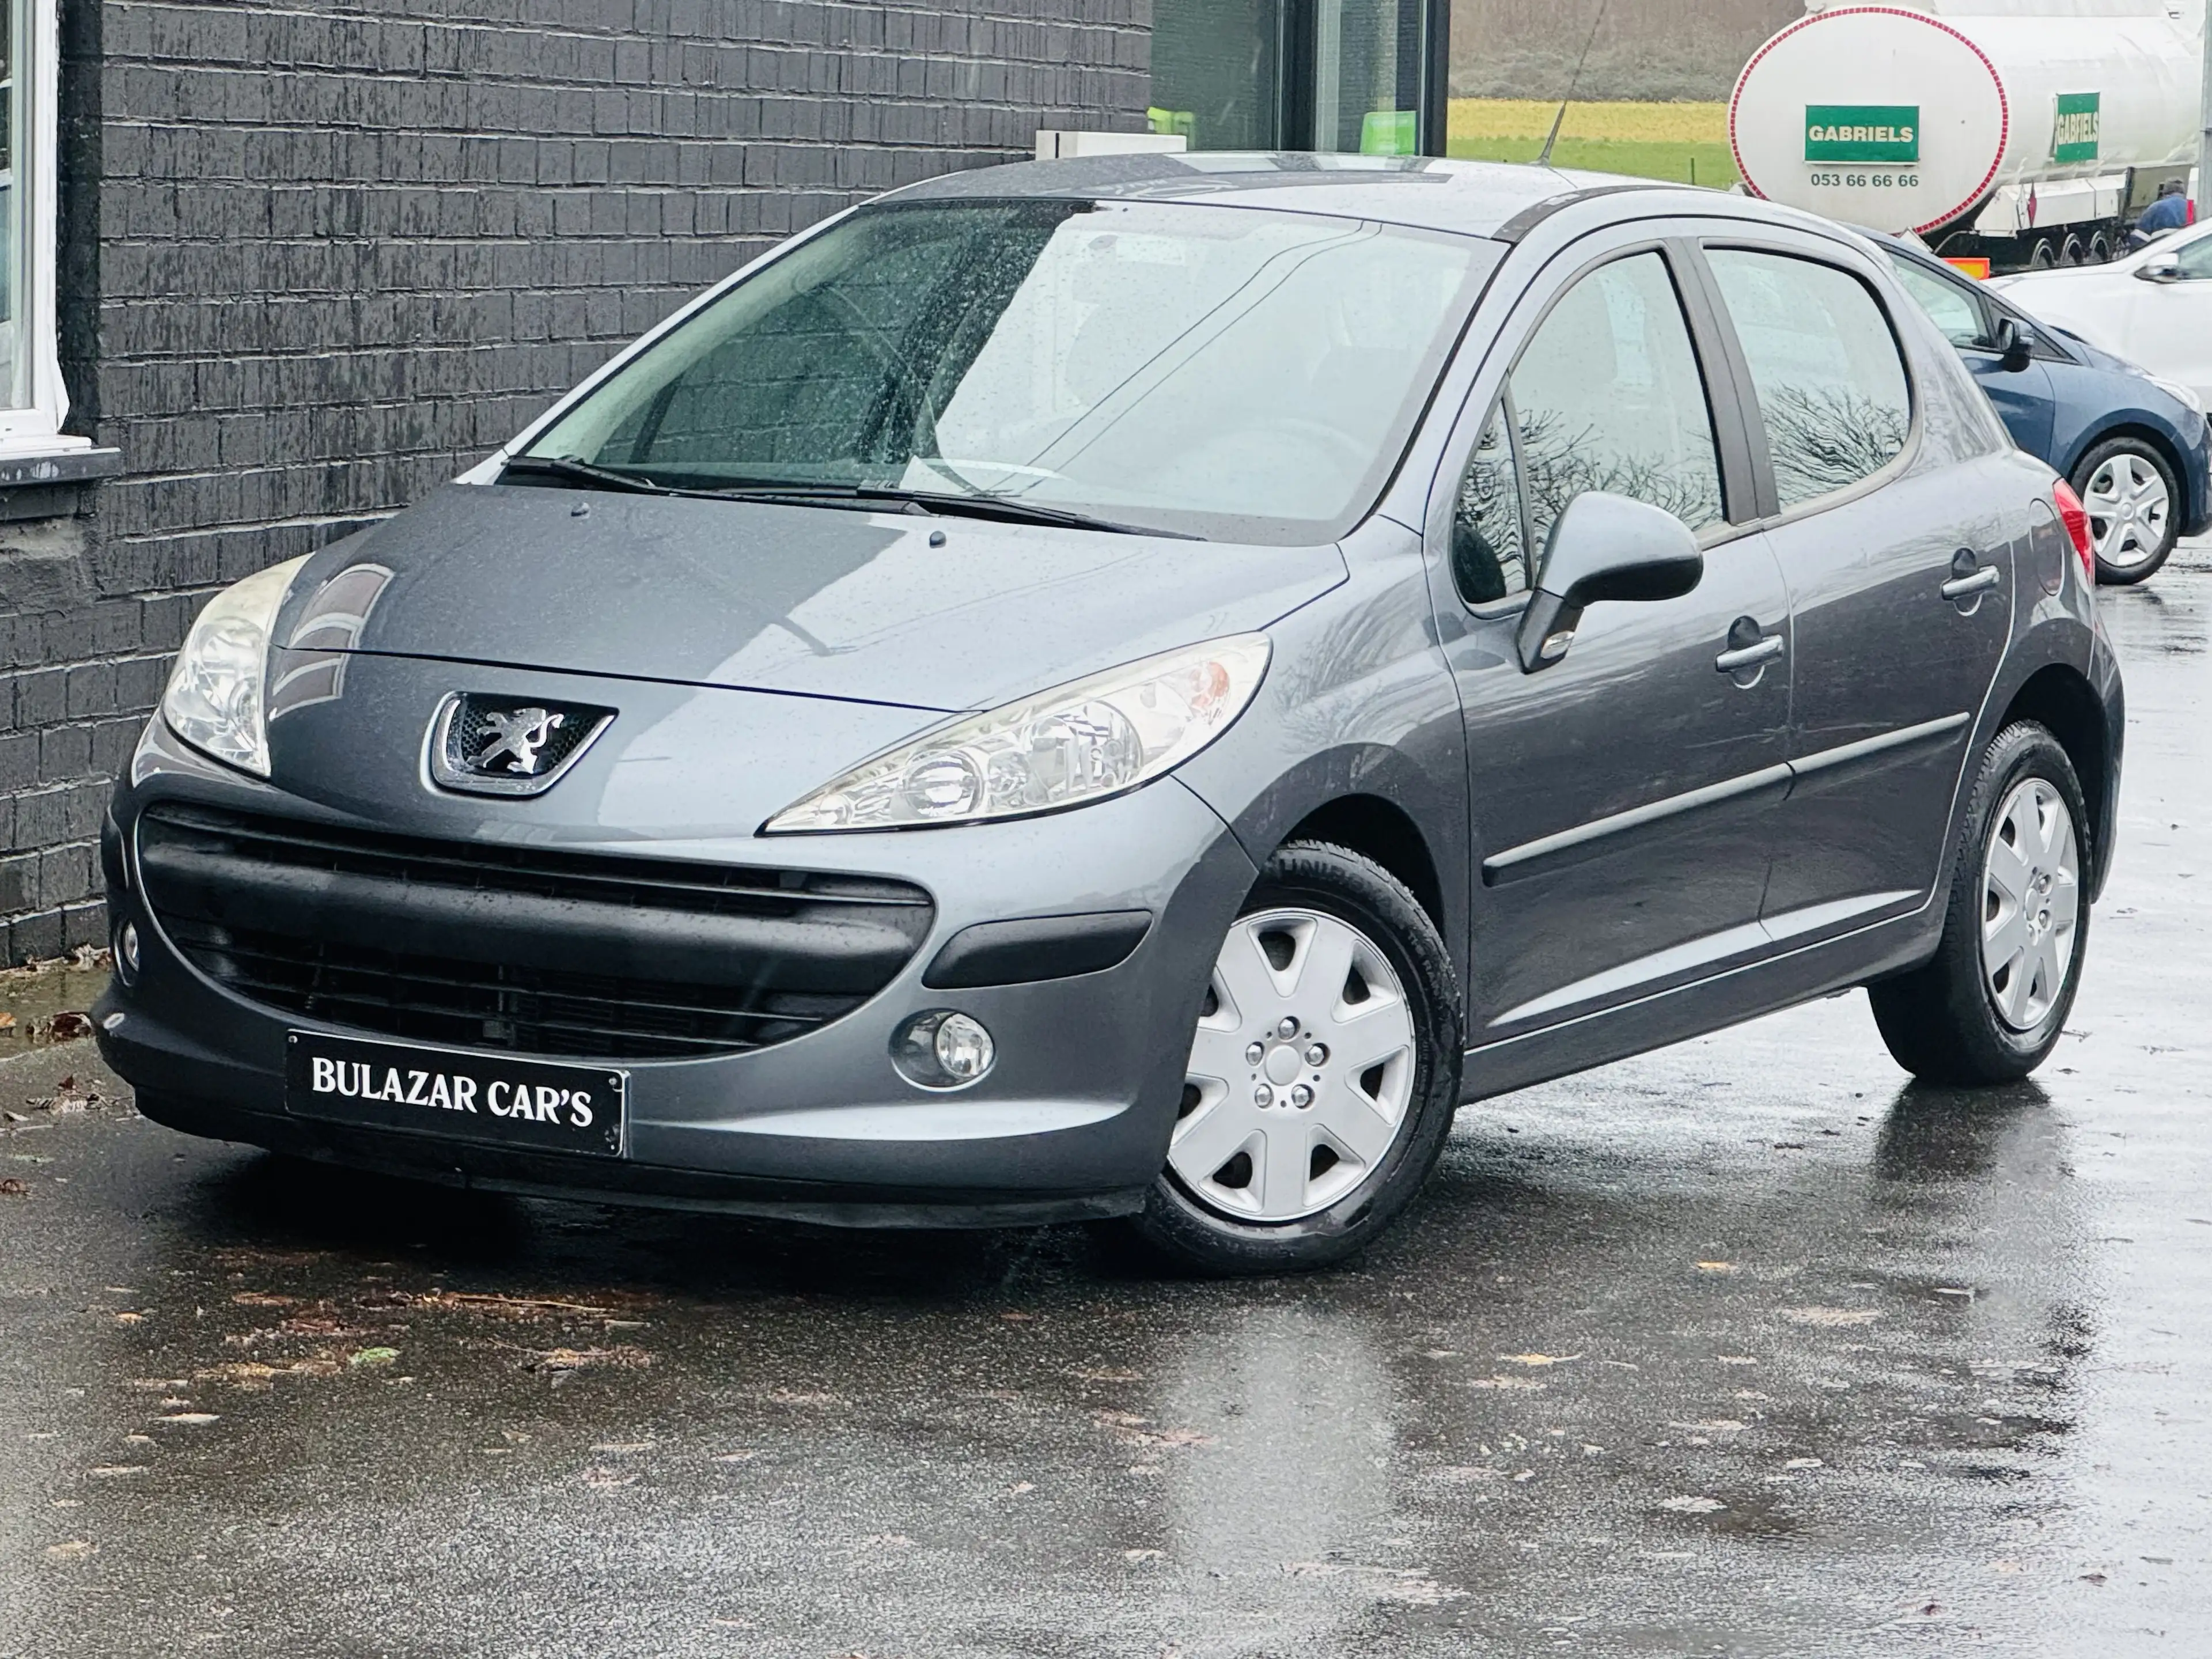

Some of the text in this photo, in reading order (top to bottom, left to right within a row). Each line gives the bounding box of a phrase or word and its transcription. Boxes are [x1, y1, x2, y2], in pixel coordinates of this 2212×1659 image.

[1809, 126, 1914, 143] GABRIELS
[1810, 173, 1919, 187] 053 66 66 66
[312, 1056, 593, 1127] BULAZAR CAR'S
